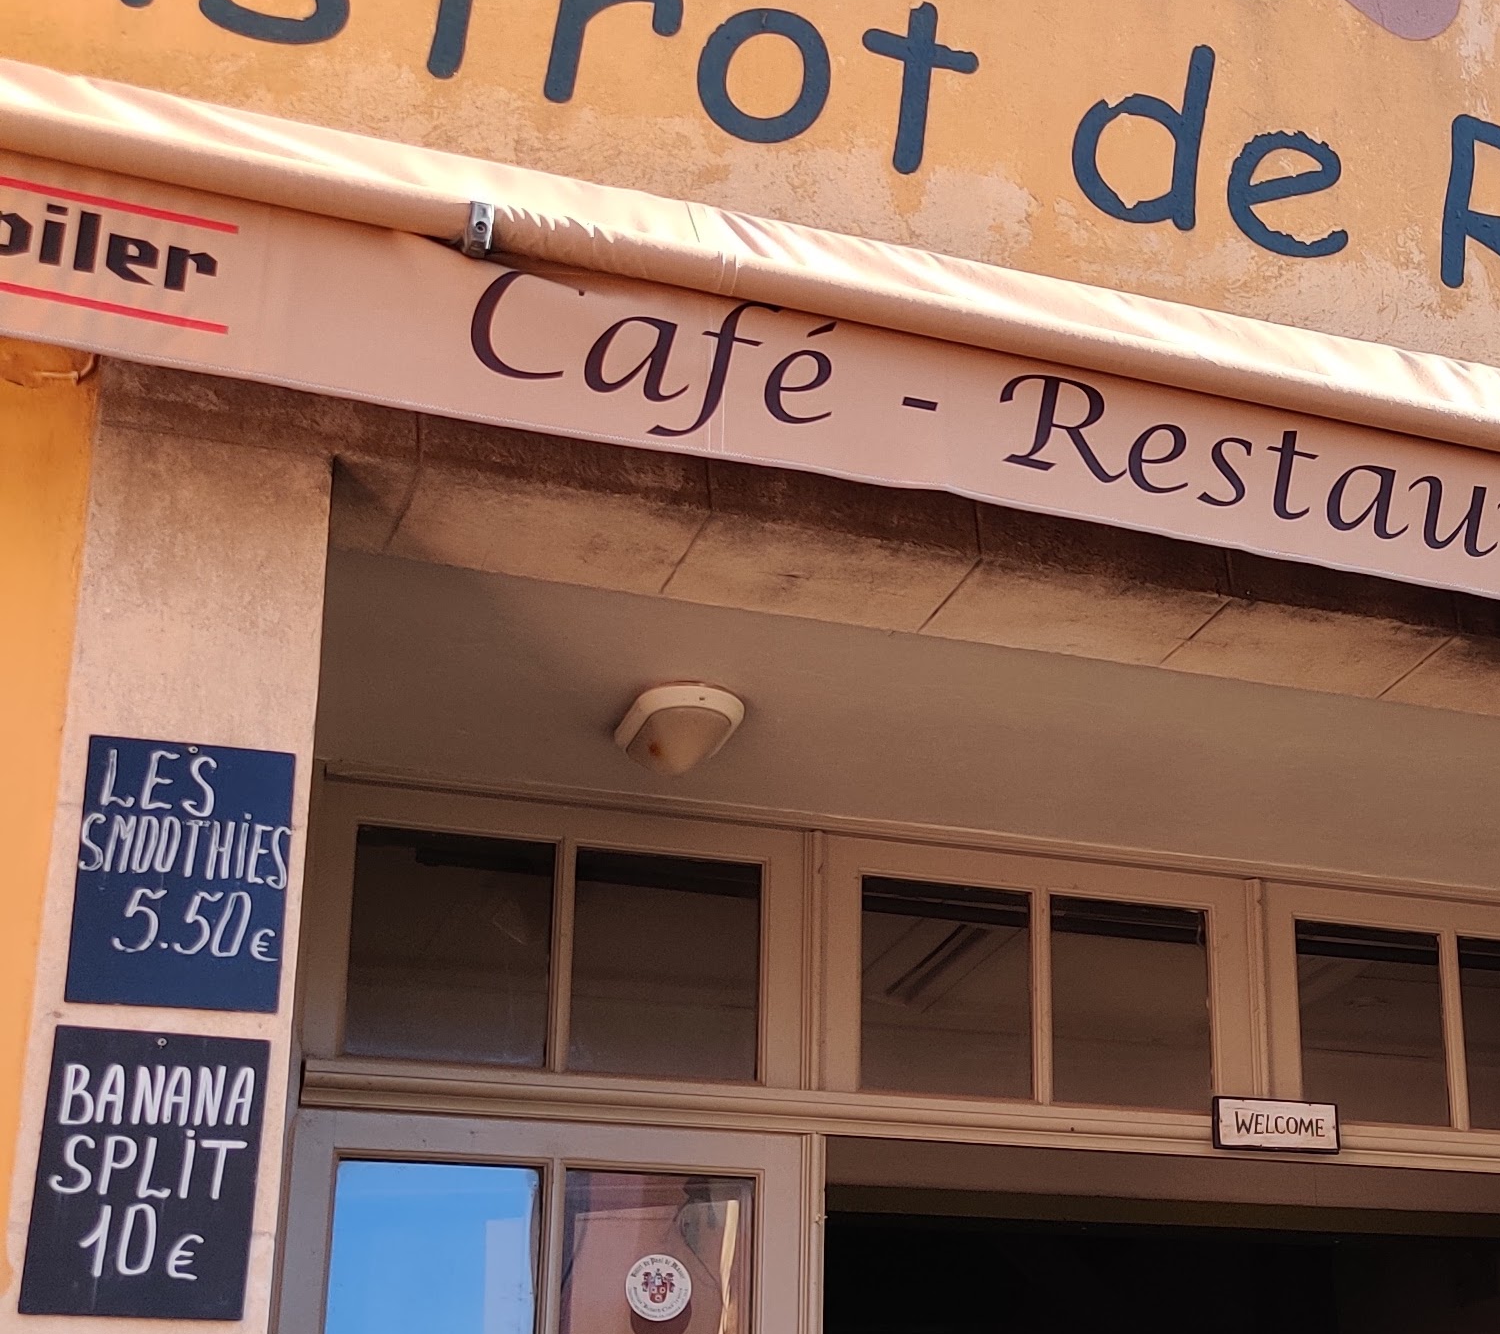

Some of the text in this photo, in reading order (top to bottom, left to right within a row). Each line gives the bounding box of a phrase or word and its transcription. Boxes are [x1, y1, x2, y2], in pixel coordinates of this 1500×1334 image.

[1072, 44, 1348, 257] de
[469, 270, 836, 437] Café
[100, 748, 217, 817] LES
[79, 813, 292, 889] SMOOTHIES
[59, 1063, 255, 1127] BANANA
[1234, 1110, 1325, 1138] WELCOME
[49, 1129, 248, 1200] SPLIT
